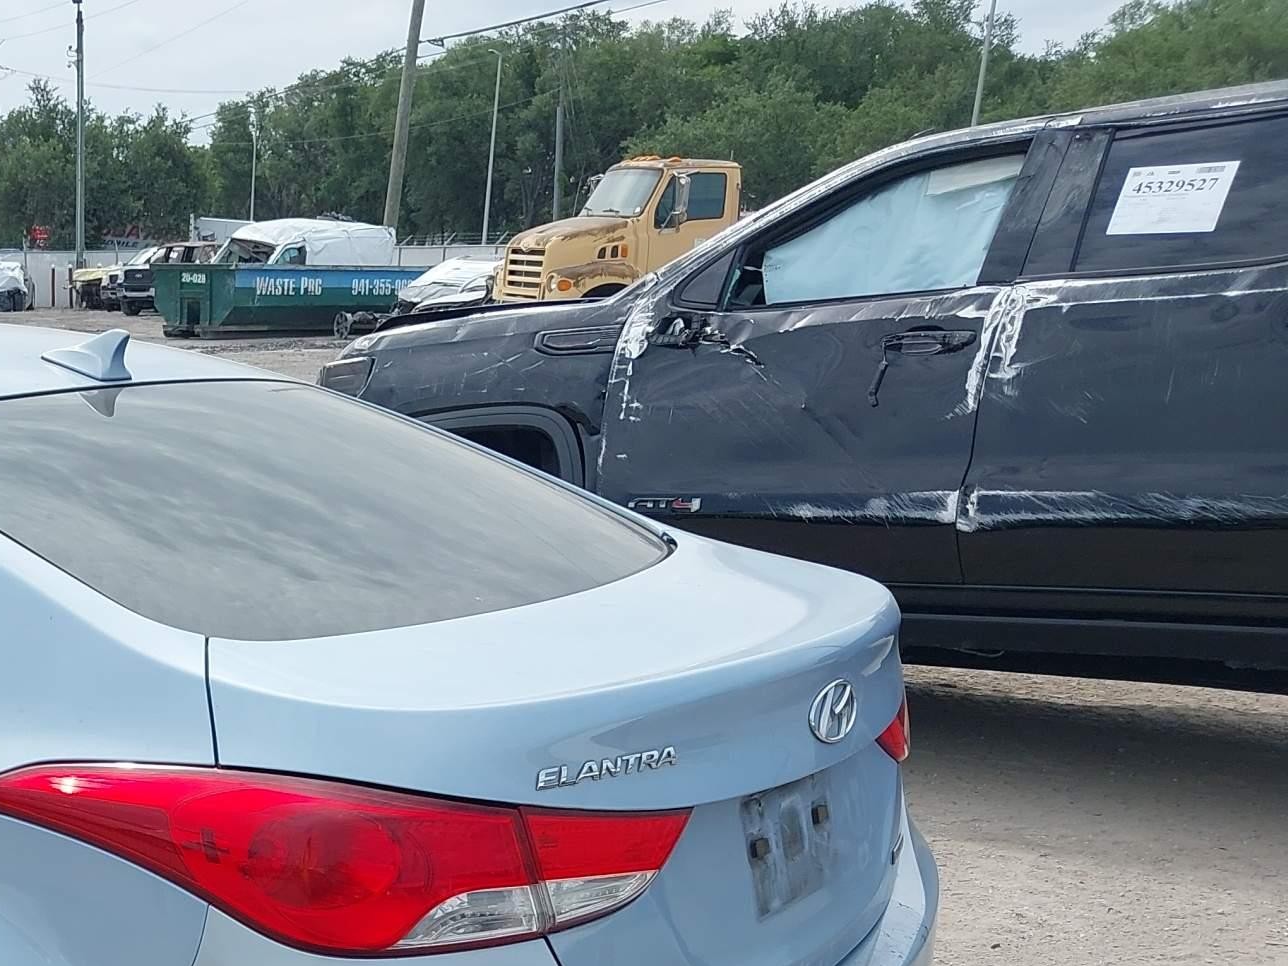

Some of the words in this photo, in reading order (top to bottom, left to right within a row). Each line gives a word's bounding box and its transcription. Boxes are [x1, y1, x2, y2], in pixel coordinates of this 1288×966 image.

[1132, 177, 1219, 194] 45329527
[256, 276, 296, 296] WASTE
[536, 746, 677, 791] ELANTRA
